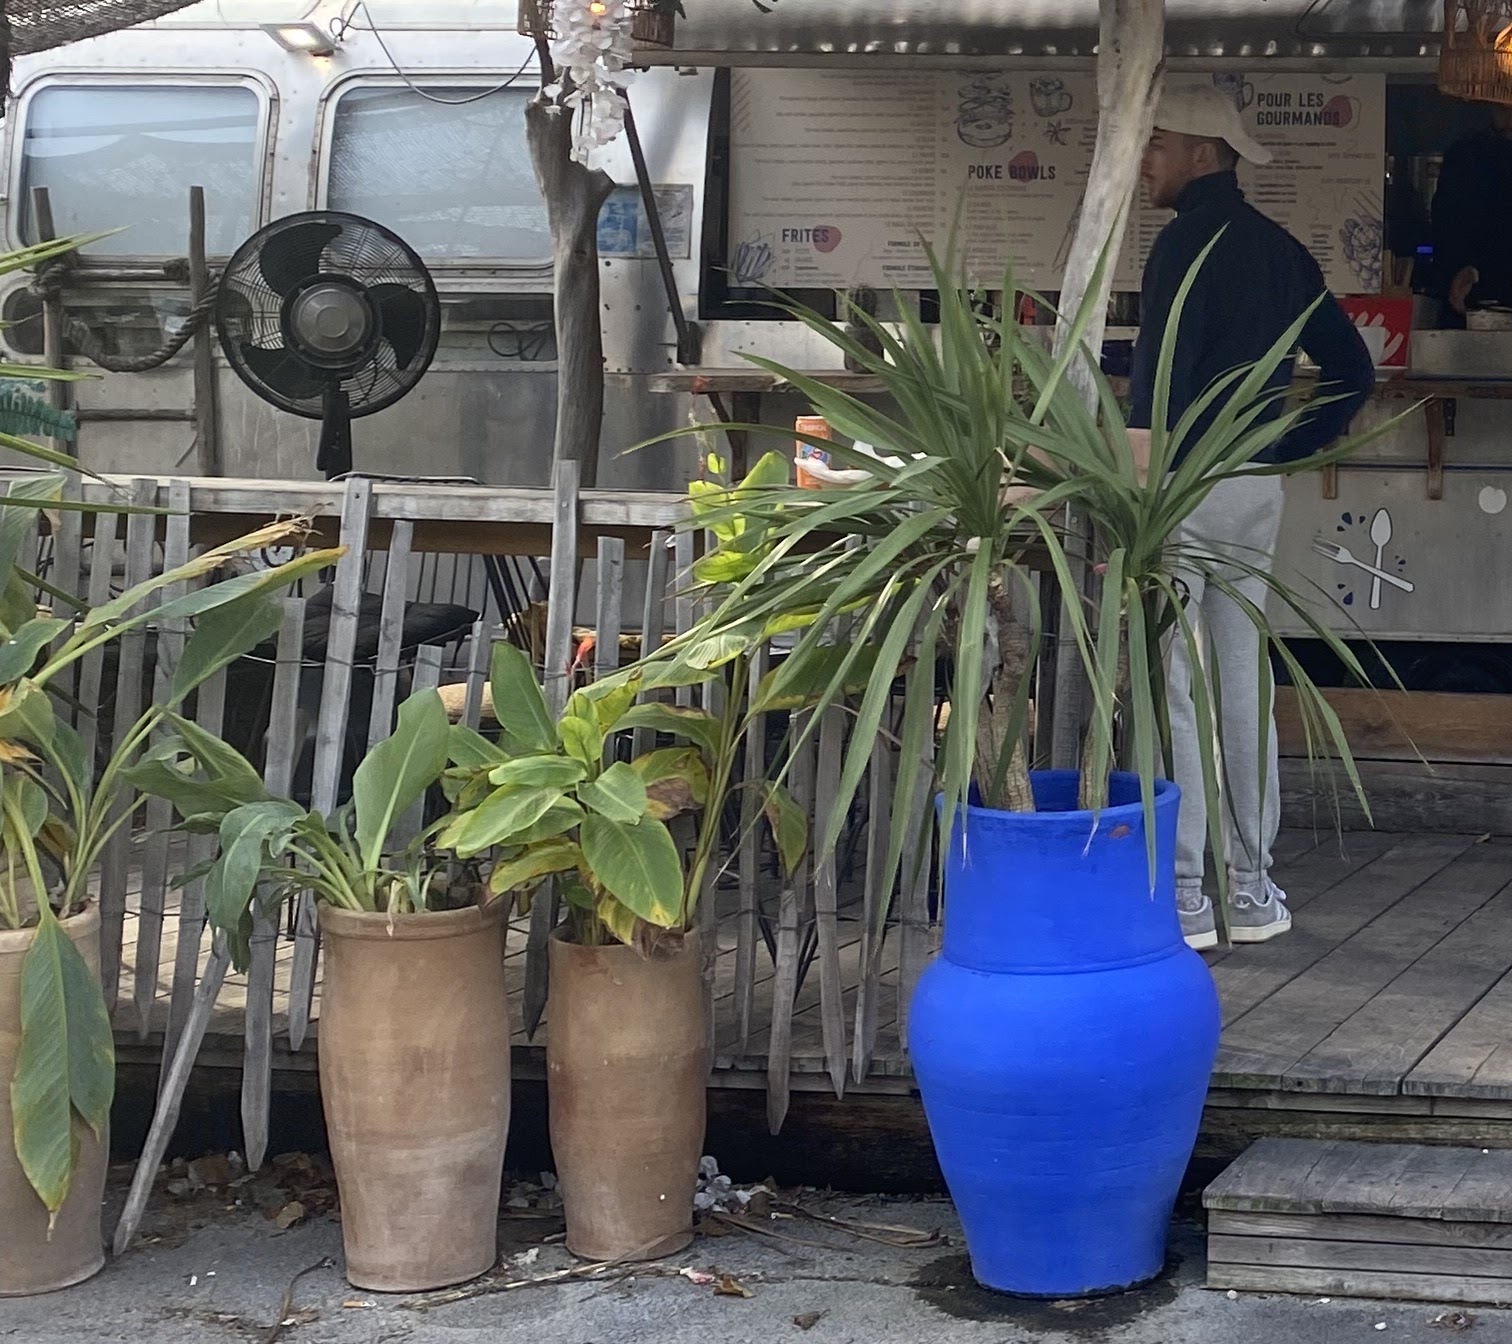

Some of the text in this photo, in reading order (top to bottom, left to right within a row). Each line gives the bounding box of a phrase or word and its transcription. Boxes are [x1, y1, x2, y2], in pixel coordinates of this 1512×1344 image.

[1257, 92, 1325, 108] POUR LES
[1256, 110, 1340, 126] GOURMANDS
[967, 164, 1056, 180] POKE BOWLS
[782, 228, 829, 243] FRITES
